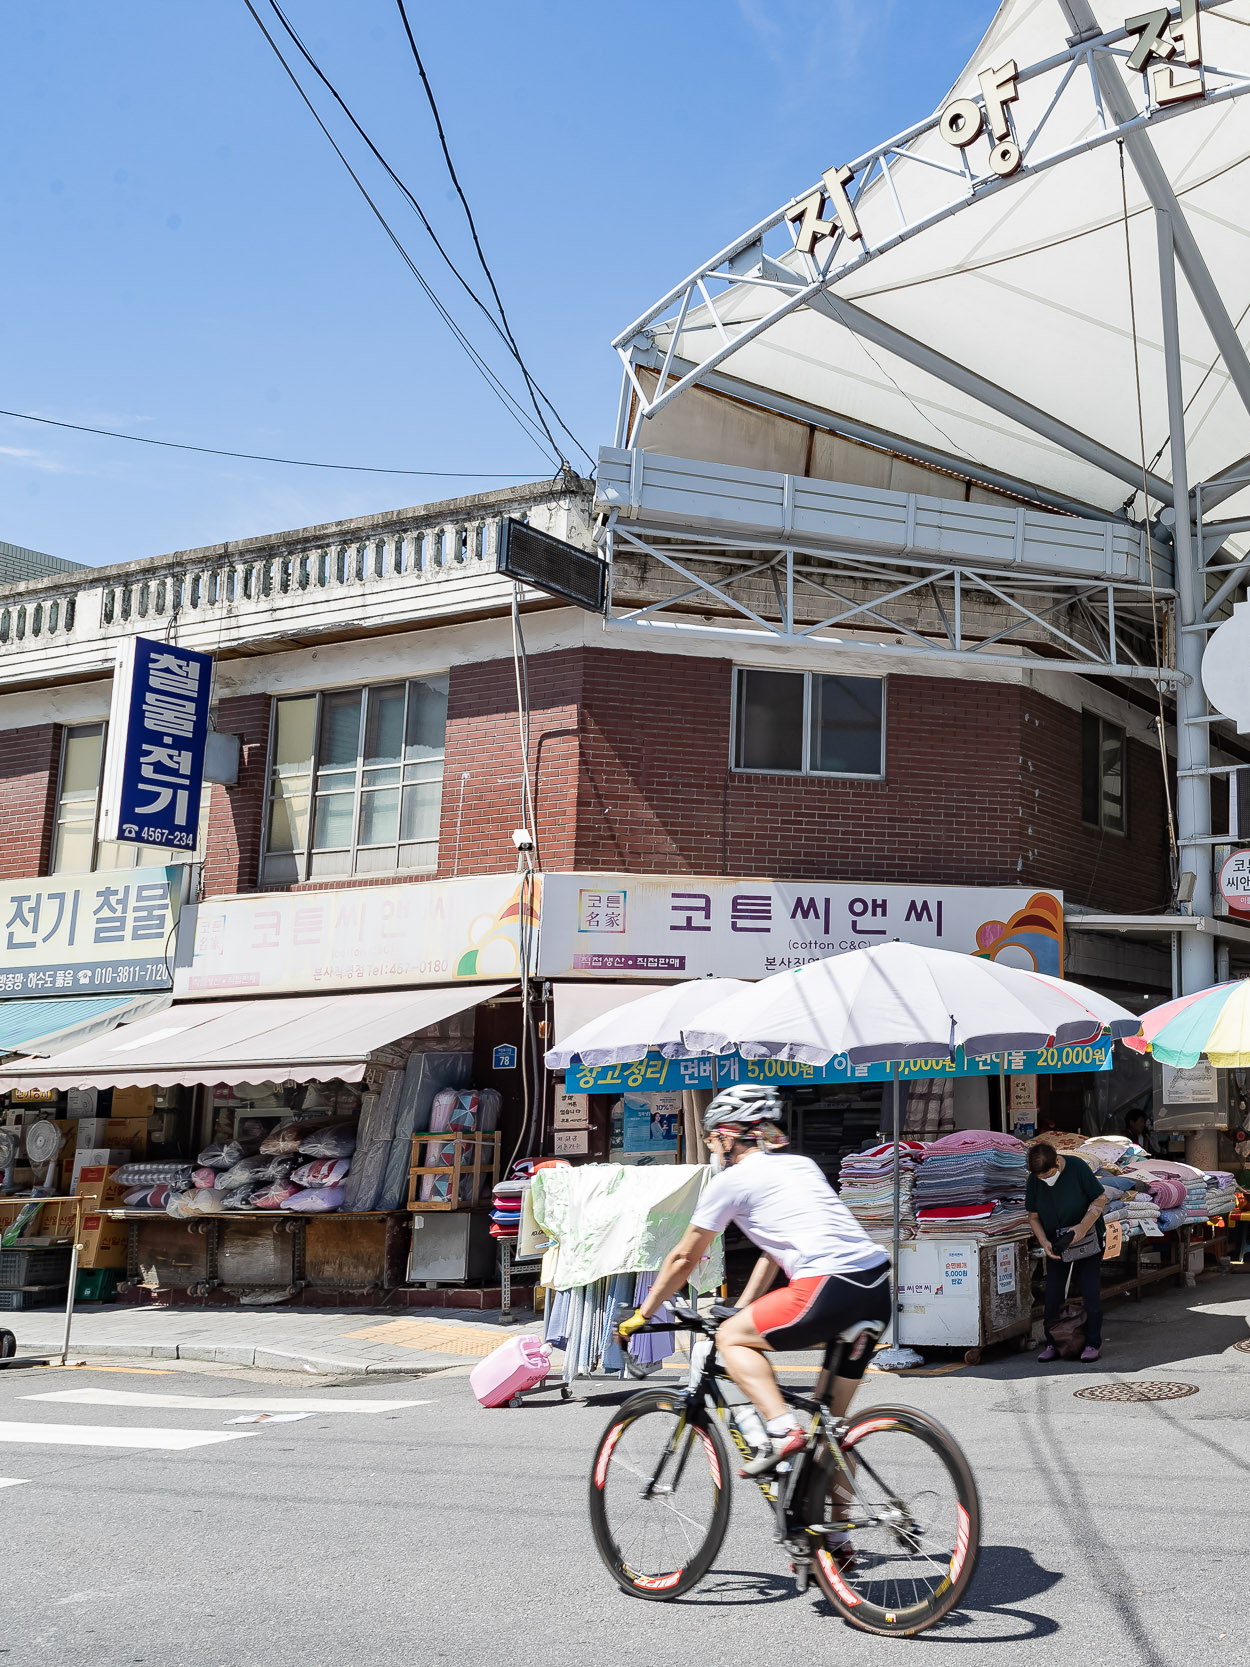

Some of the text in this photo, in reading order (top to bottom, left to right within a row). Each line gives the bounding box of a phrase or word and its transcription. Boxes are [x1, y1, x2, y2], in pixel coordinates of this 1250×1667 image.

[141, 826, 194, 847] 4567-234
[587, 894, 621, 909] 코튼
[5, 881, 171, 951] 전기 철물
[585, 911, 620, 928] 名家
[669, 892, 943, 937] 코튼씨앤씨
[788, 939, 835, 951] (cotton
[55, 969, 74, 988] 뚫음
[499, 1055, 510, 1066] 78
[1036, 1045, 1106, 1069] 20,000원
